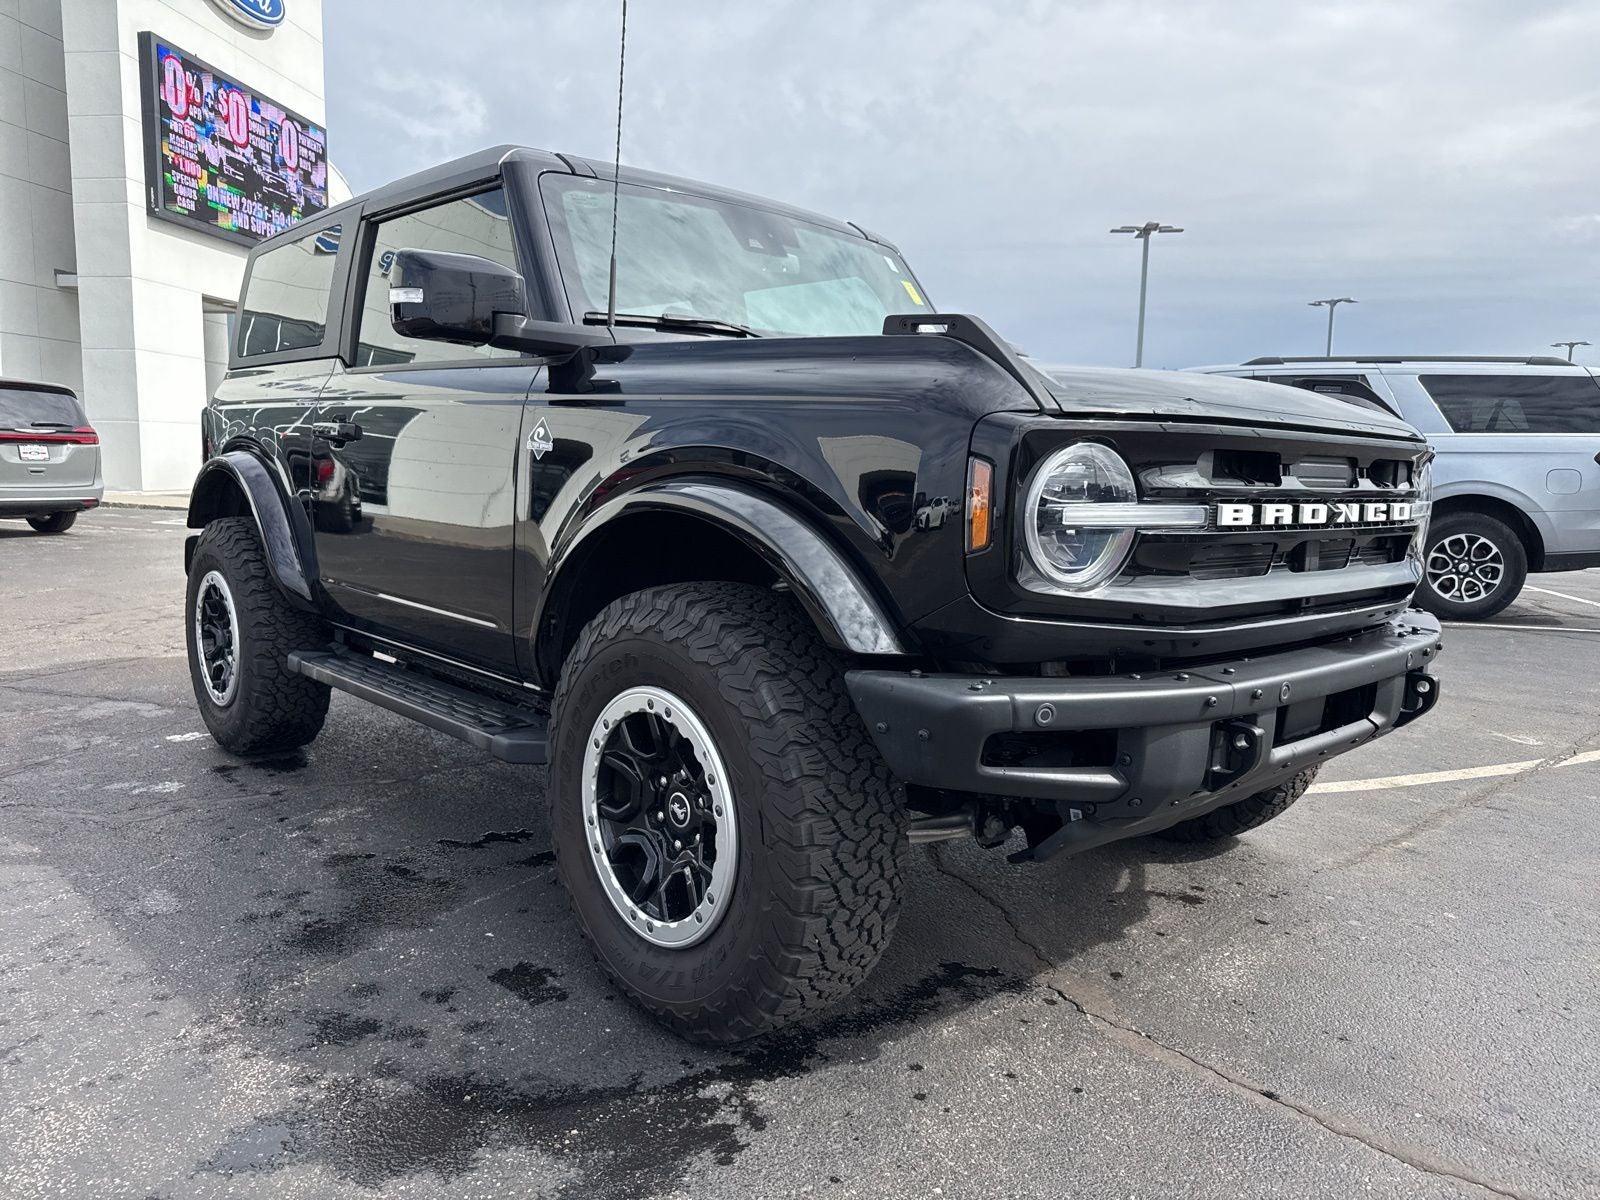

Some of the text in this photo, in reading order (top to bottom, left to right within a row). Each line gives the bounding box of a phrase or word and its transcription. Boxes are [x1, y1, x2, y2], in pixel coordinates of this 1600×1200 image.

[217, 88, 249, 148] $0
[177, 195, 196, 211] CASH
[241, 197, 263, 219] 2025
[1217, 502, 1412, 526] BRONCO
